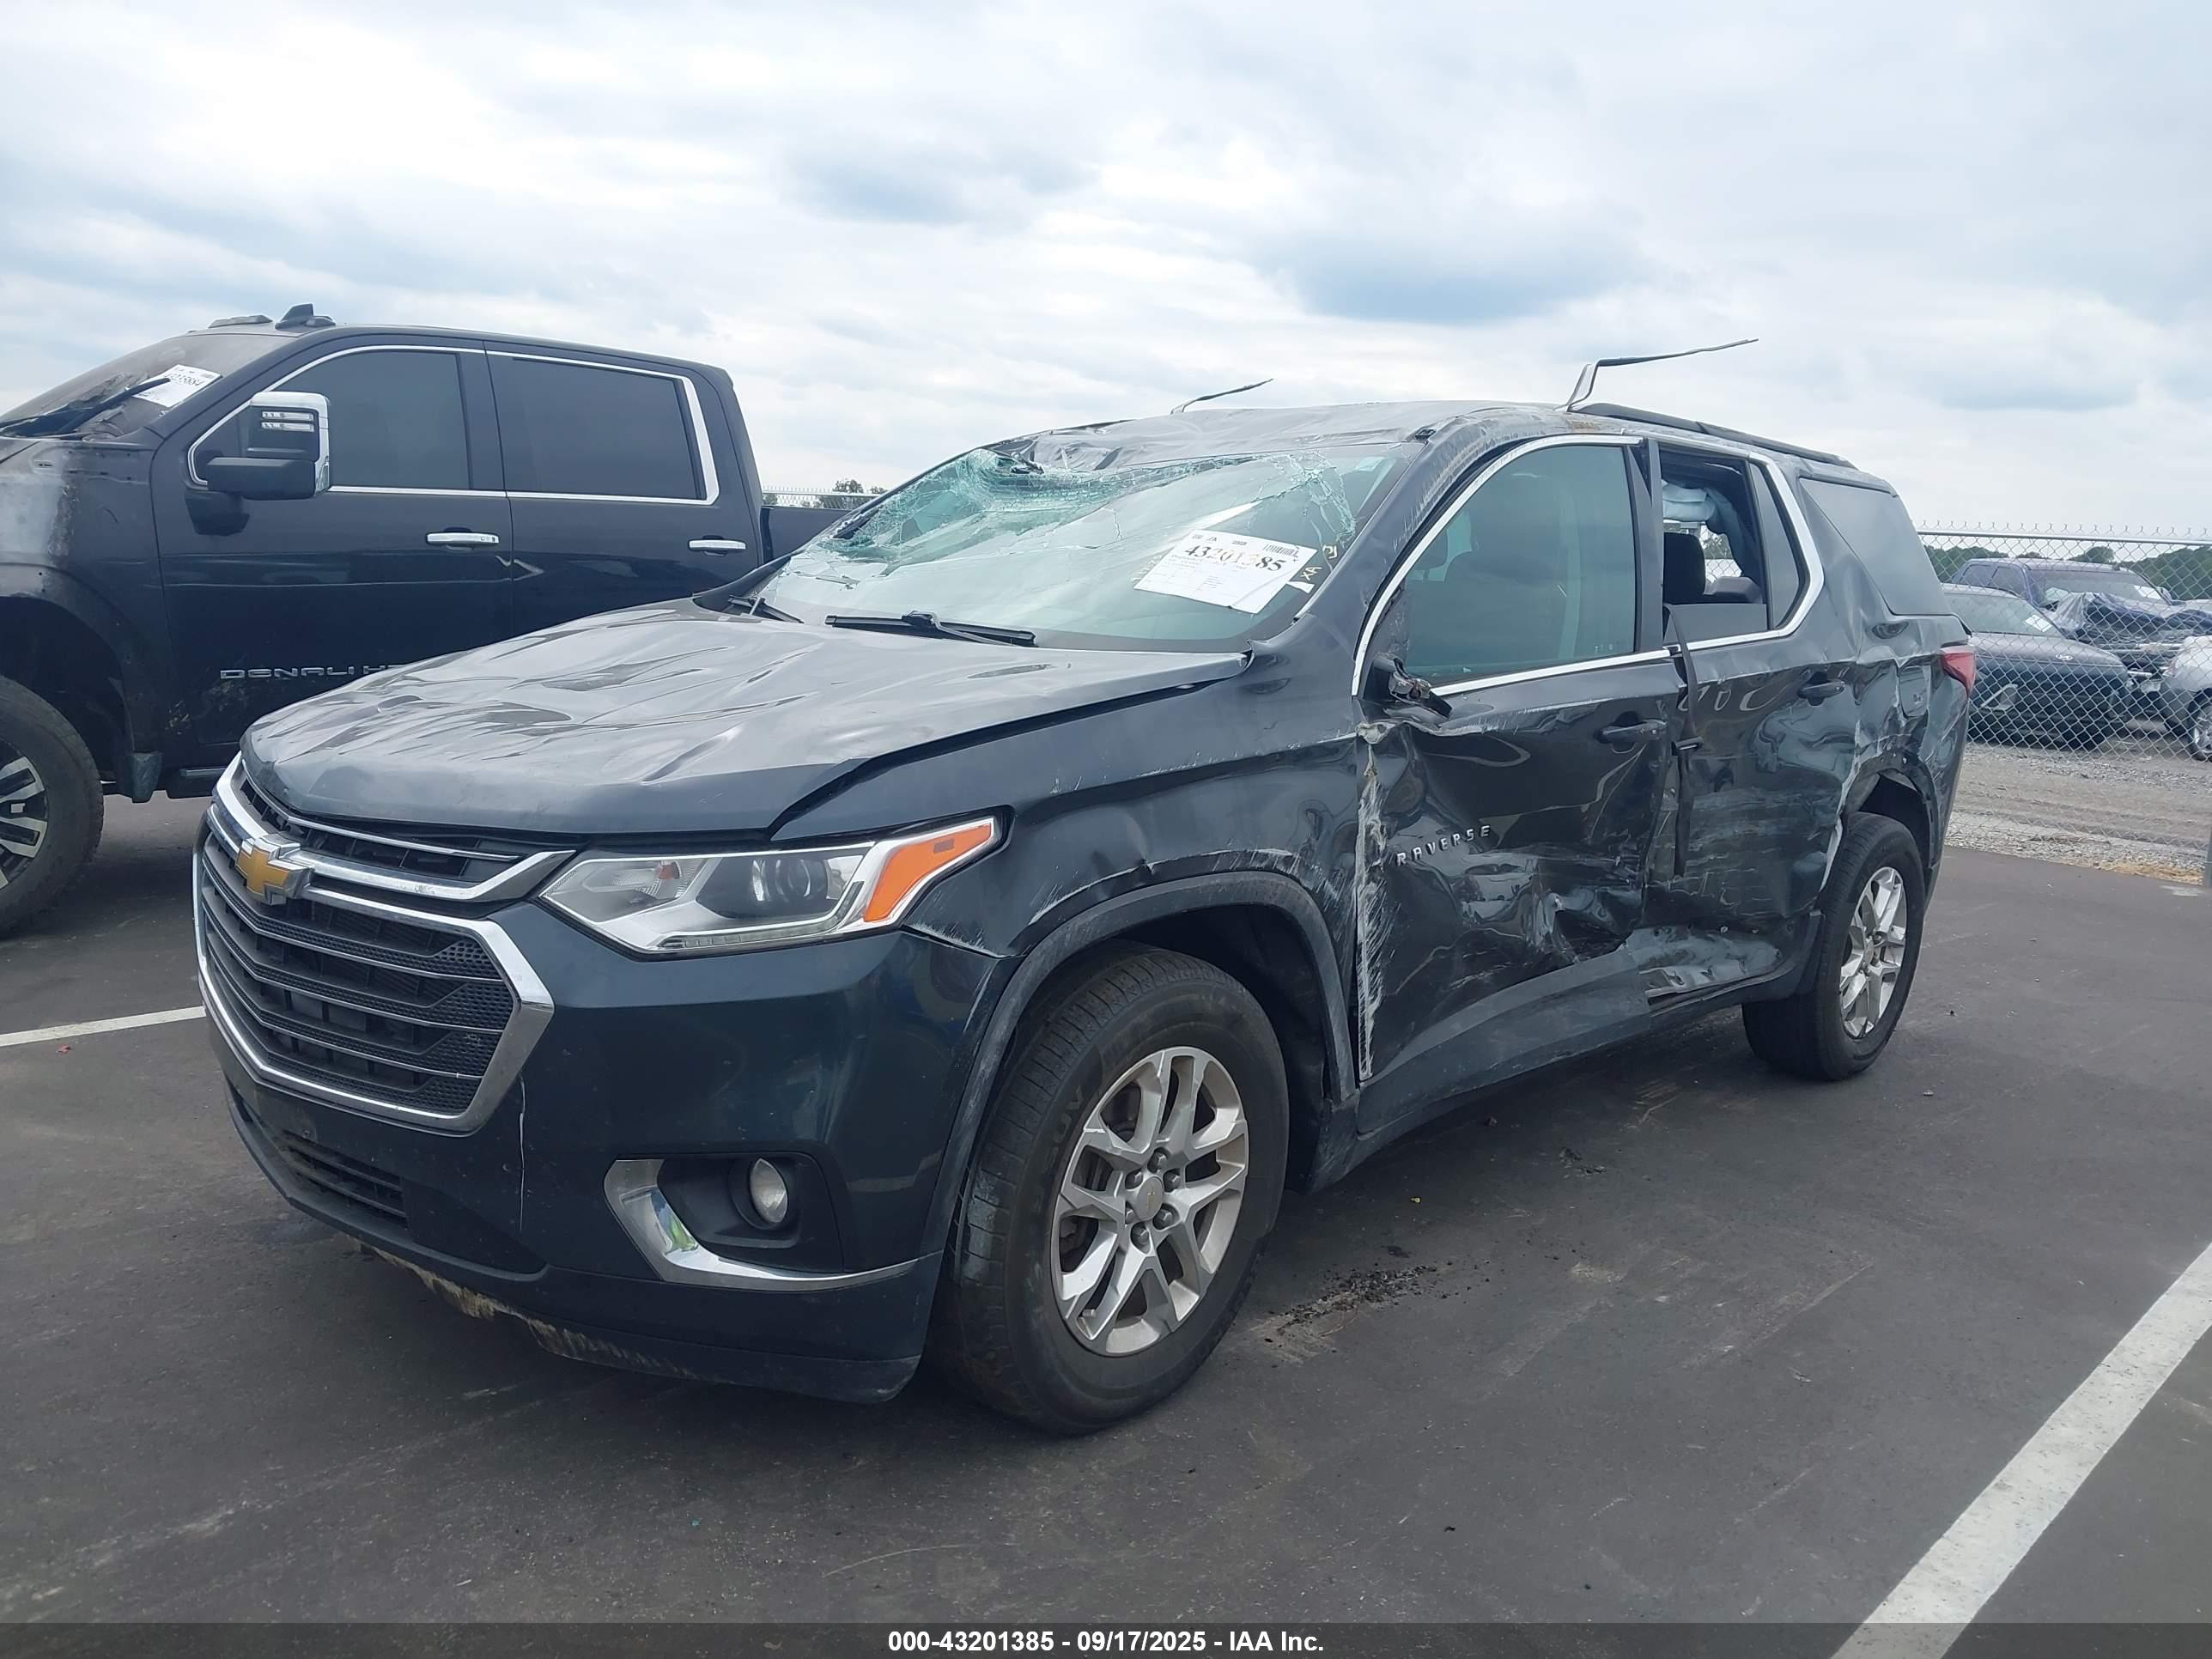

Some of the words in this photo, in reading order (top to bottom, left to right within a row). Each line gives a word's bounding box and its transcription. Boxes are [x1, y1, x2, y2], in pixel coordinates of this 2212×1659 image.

[1184, 544, 1287, 572] 43201385
[220, 666, 355, 679] DENALI
[1396, 825, 1491, 866] RAVERSE
